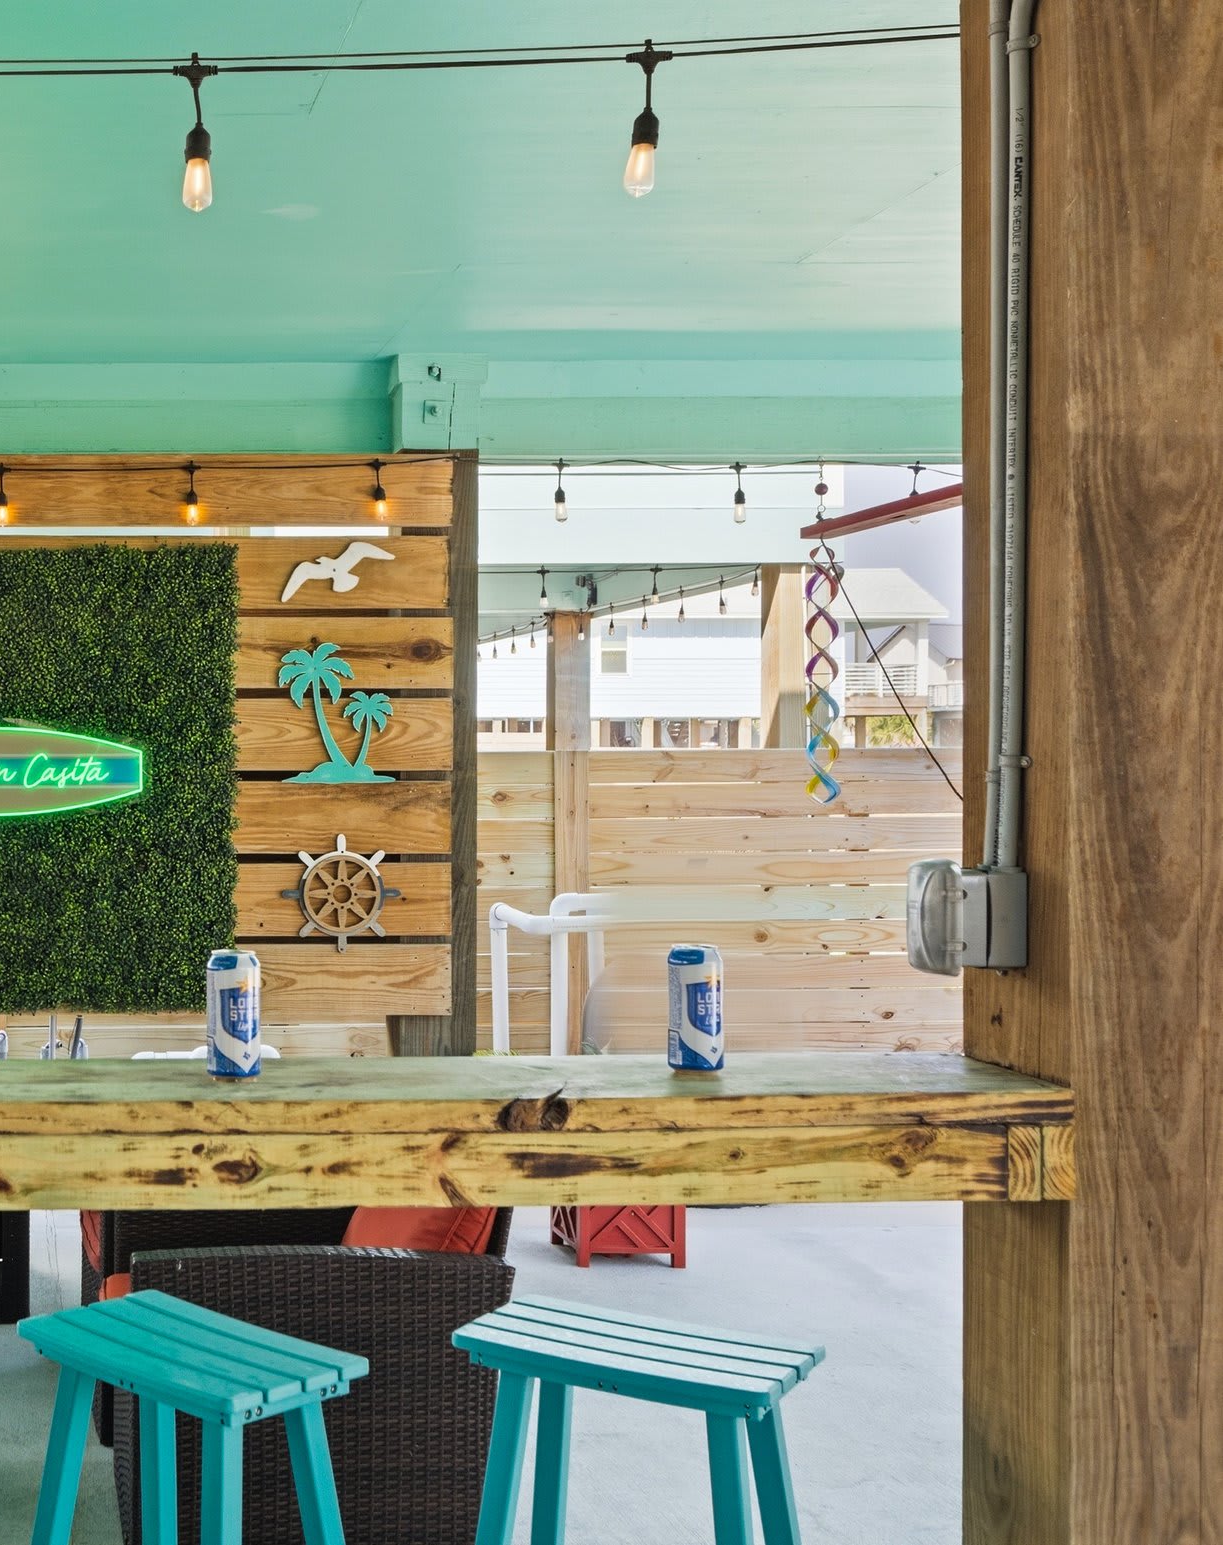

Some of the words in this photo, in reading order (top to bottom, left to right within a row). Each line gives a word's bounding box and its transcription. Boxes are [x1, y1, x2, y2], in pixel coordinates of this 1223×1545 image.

[1012, 205, 1022, 248] SCHEDULE
[1011, 253, 1021, 263] 40
[1010, 268, 1020, 295] RIGID
[1010, 300, 1019, 316] PVC
[1008, 384, 1018, 421] CONDUIT
[23, 752, 109, 790] Casita
